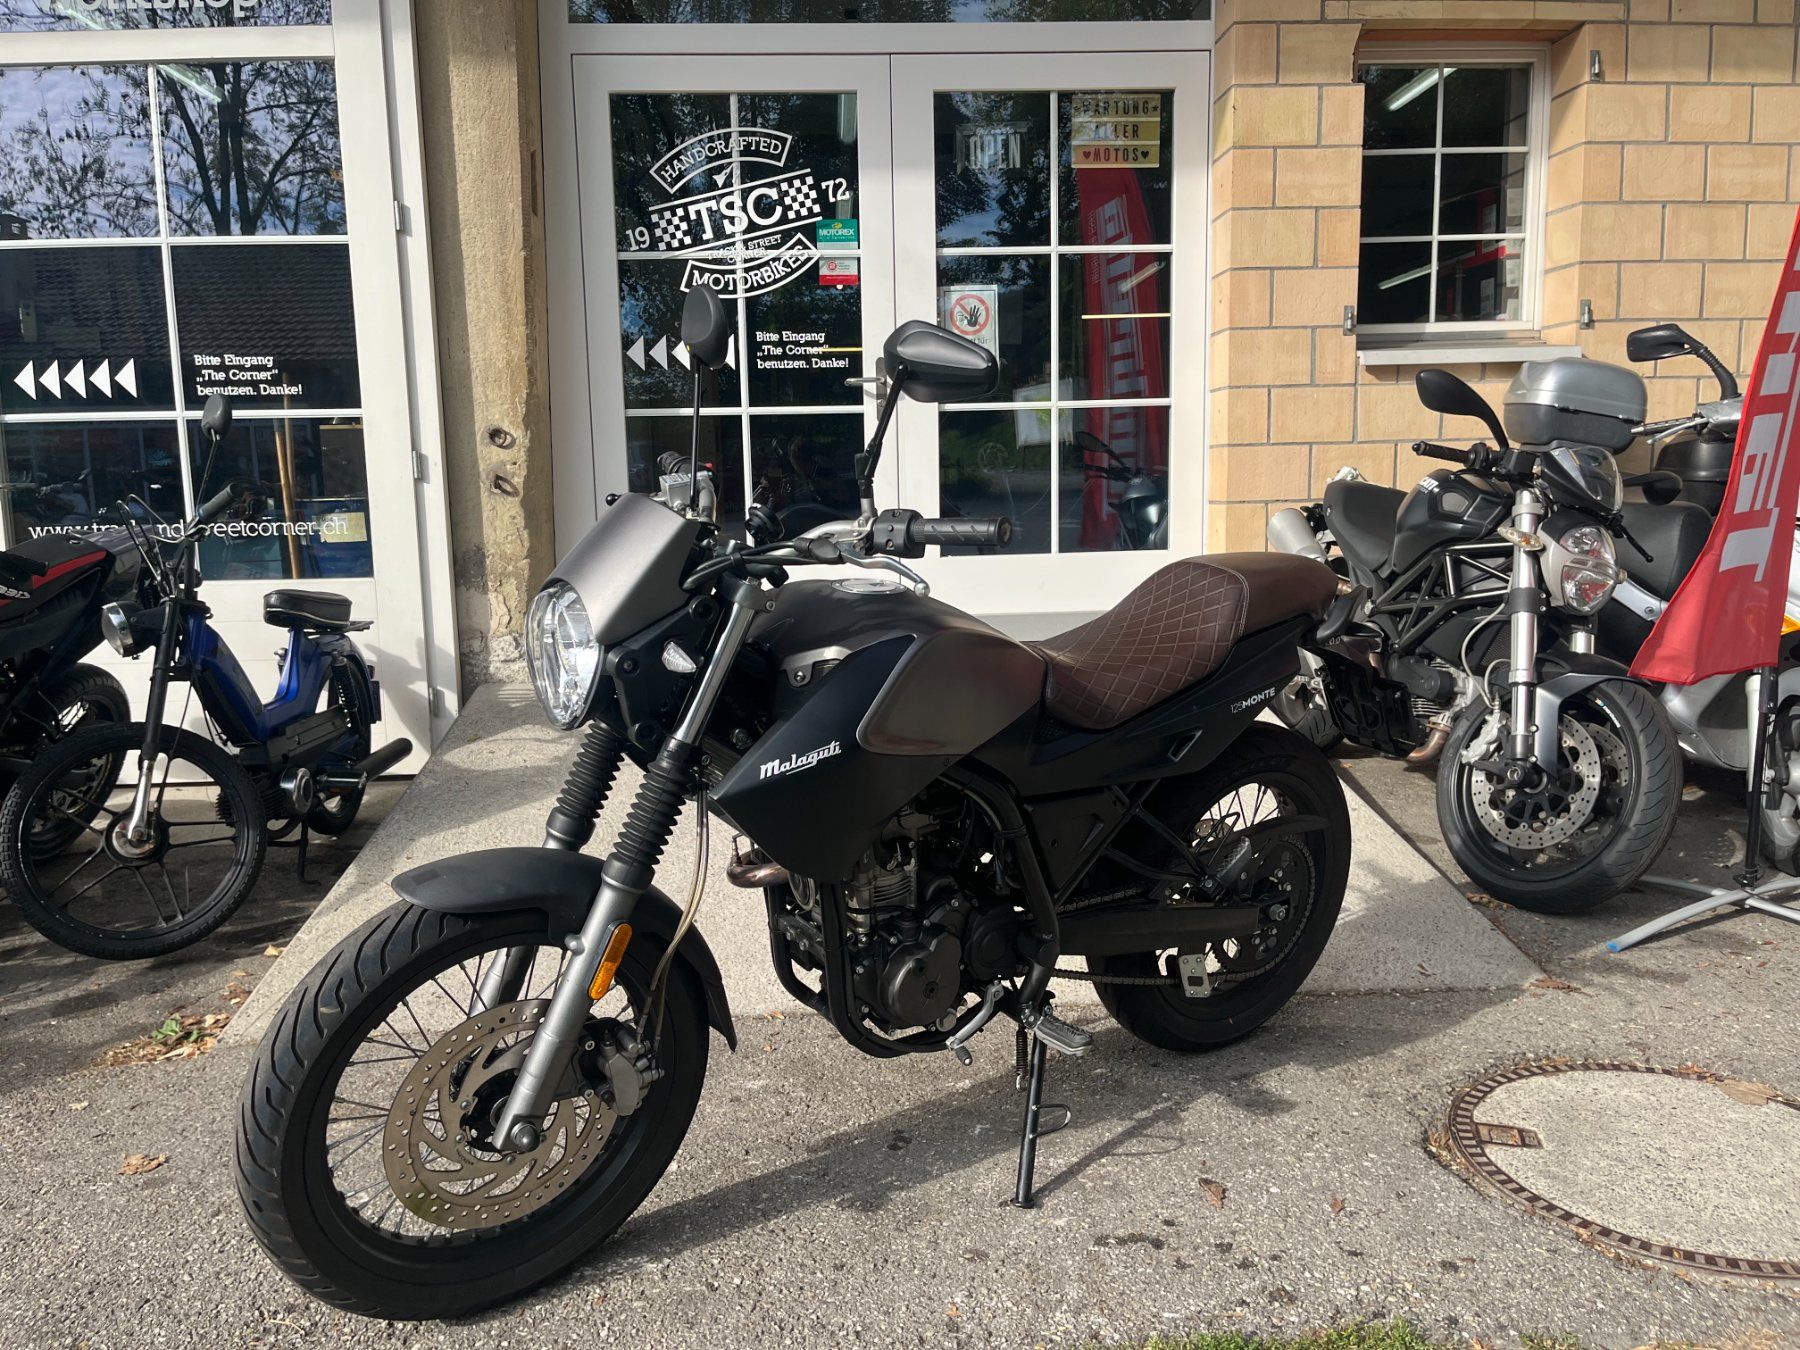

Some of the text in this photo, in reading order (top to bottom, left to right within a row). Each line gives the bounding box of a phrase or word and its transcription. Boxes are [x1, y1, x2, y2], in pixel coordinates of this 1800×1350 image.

[969, 133, 1021, 169] OPEN
[1093, 147, 1139, 162] MOTOS
[661, 136, 782, 183] HANDCRAFTED
[625, 177, 850, 252] 19 TSC 72
[819, 228, 855, 236] MOTOREX
[748, 235, 782, 250] STREET
[692, 244, 811, 290] MOTORBIKES
[756, 331, 826, 343] Bitte Eingang
[193, 354, 273, 368] Bitte Eingang
[756, 358, 849, 369] benutzen. Danke!
[196, 383, 302, 396] benutzen. Danke!
[760, 740, 842, 780] Malaguti
